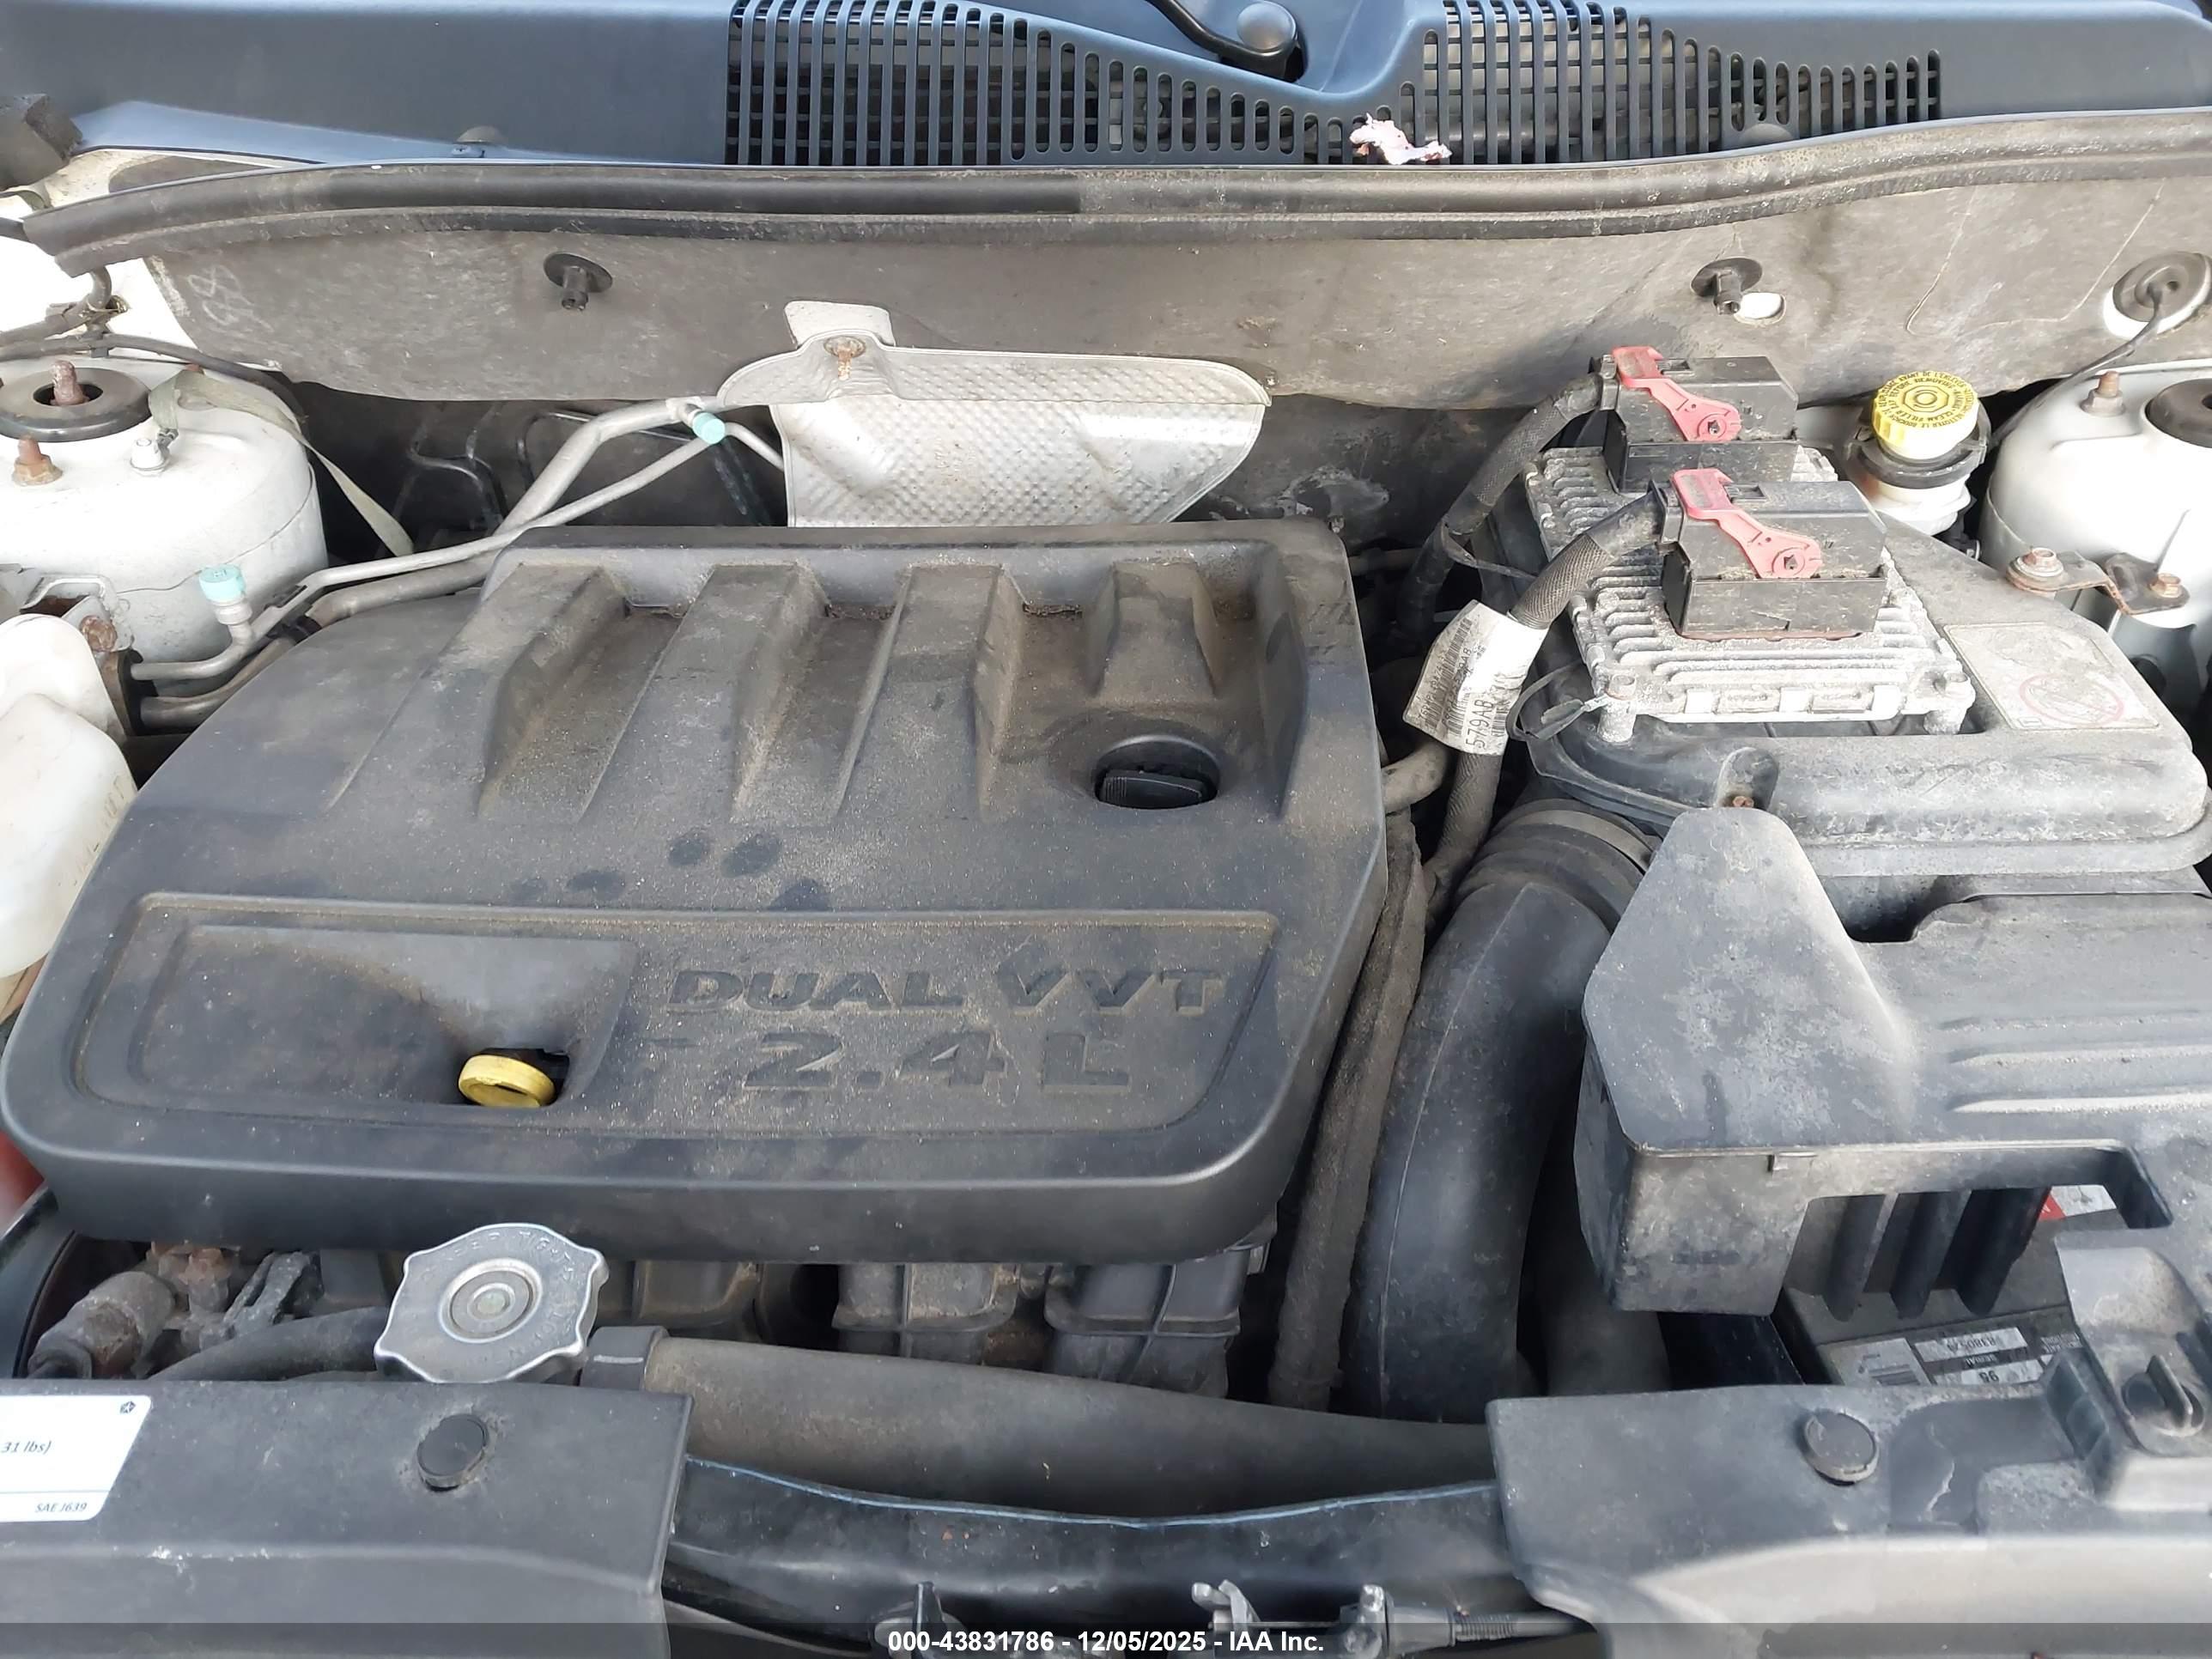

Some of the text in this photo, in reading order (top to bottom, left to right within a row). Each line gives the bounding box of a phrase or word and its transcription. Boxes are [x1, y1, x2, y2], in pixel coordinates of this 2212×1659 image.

[1466, 699, 1494, 750] 579AB
[665, 970, 1223, 1013] DUAL VVT
[23, 1440, 52, 1455] lbs)
[35, 1503, 88, 1513] SAE J639
